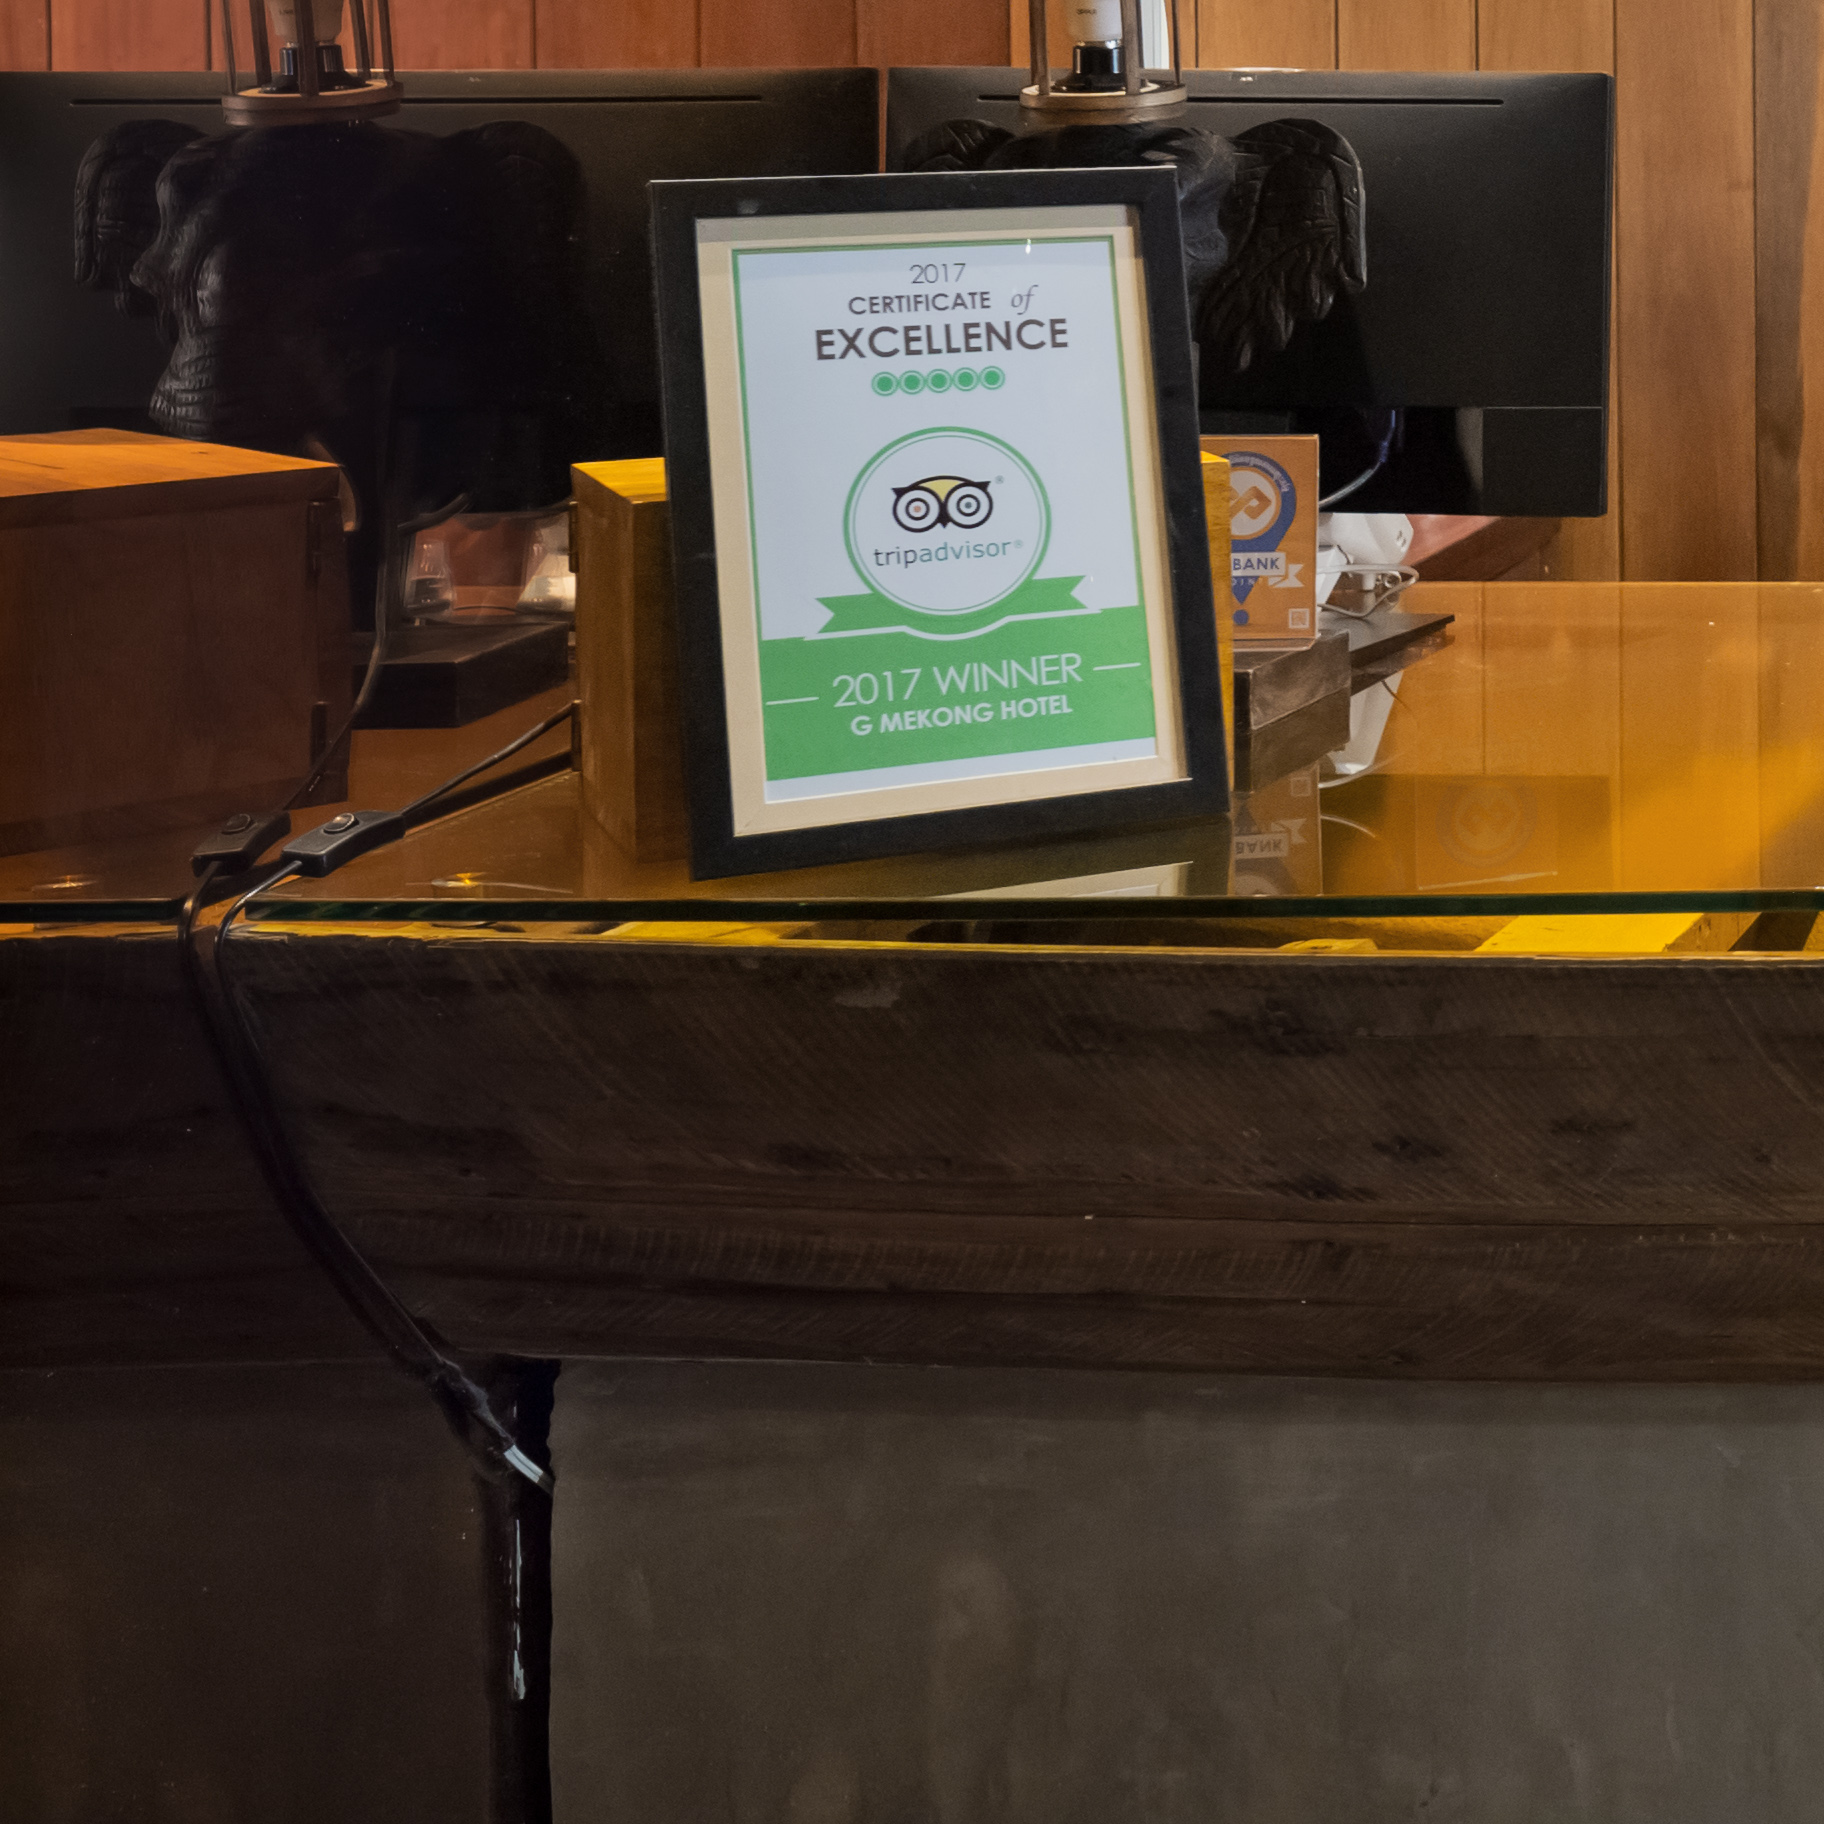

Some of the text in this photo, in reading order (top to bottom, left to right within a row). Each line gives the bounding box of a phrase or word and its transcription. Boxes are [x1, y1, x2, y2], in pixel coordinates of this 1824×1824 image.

[909, 262, 966, 284] 2017
[848, 284, 1039, 315] CERTIFICATE of
[815, 318, 1068, 360] EXCELLENCE
[873, 541, 1012, 569] tripadvisor
[1232, 557, 1280, 571] BANK
[832, 652, 1084, 708] 2017 WINNER
[851, 694, 1073, 736] G MEKONG HOTEL
